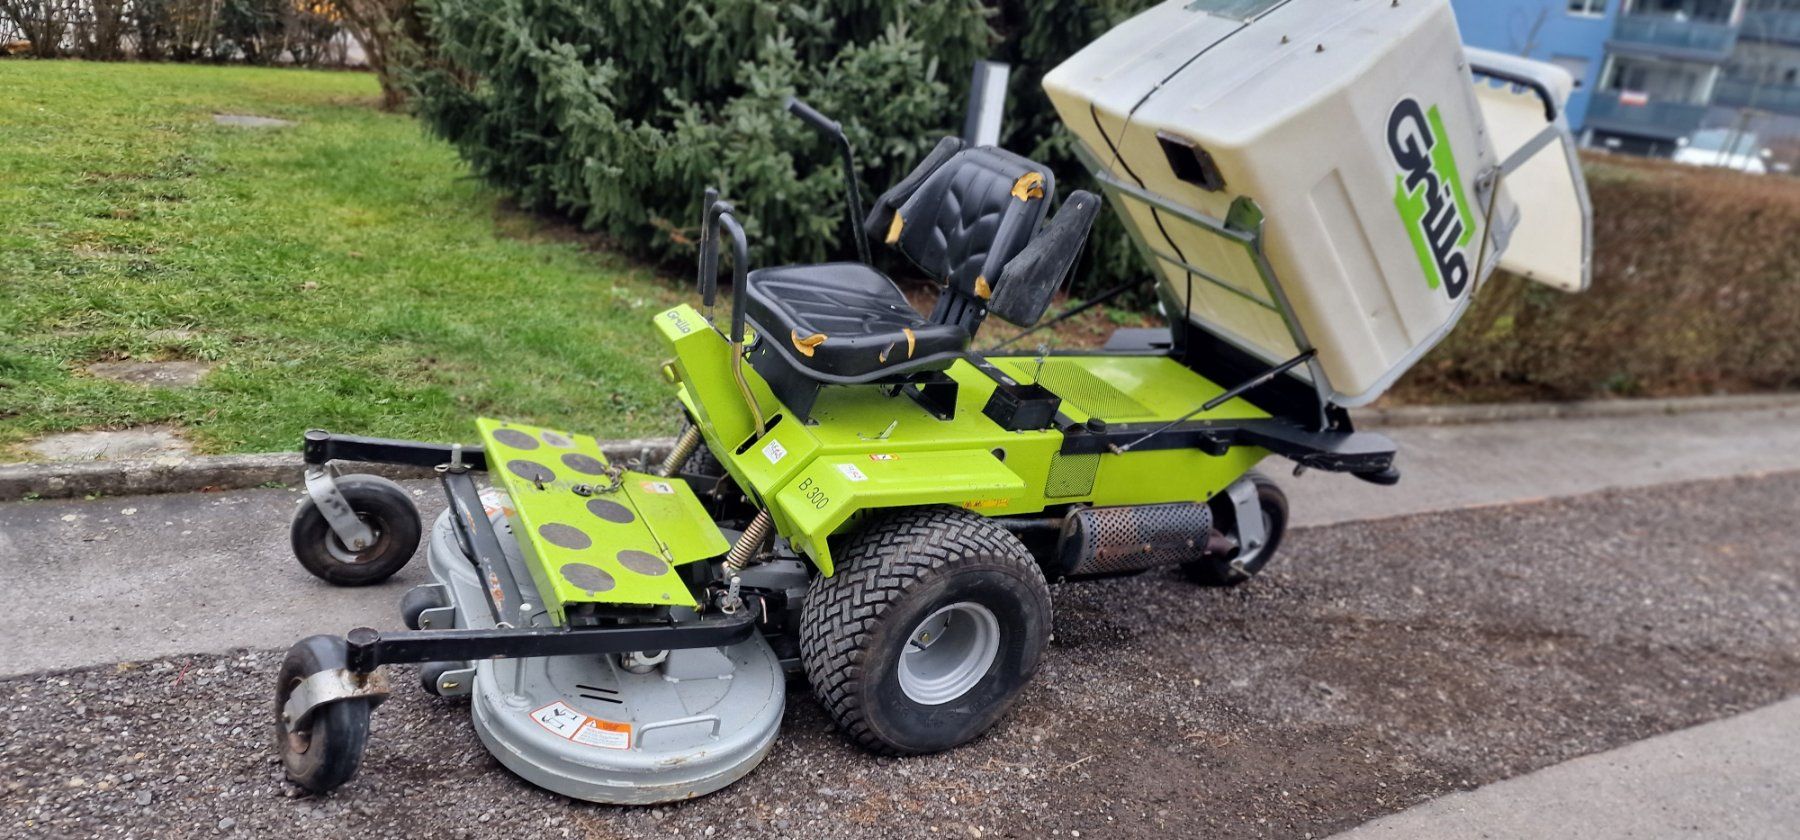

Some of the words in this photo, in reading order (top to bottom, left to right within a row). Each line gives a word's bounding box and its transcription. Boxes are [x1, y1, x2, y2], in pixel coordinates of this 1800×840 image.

[1387, 97, 1469, 300] Grillo
[666, 310, 691, 334] Grillo
[798, 477, 813, 491] B
[806, 487, 829, 510] 300
